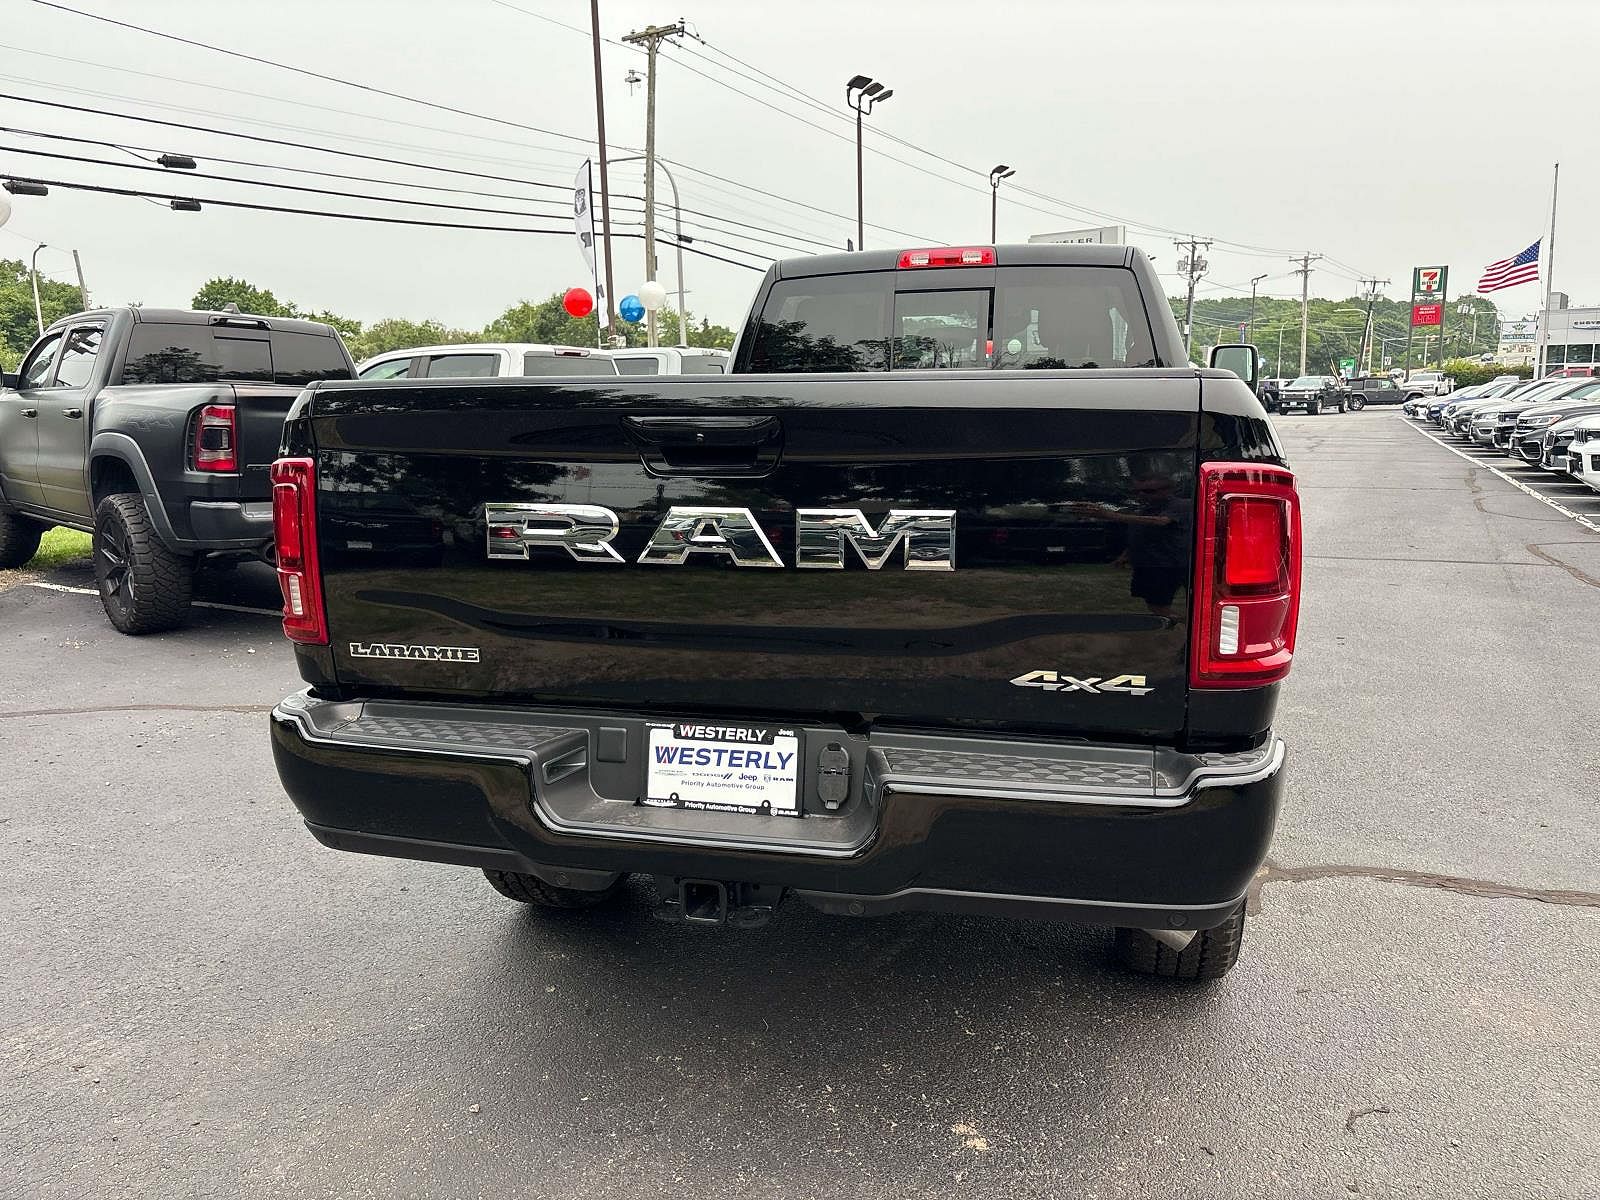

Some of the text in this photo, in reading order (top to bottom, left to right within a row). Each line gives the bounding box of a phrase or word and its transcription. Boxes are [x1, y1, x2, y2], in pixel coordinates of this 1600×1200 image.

[1422, 271, 1438, 293] 7
[485, 502, 957, 572] RAM
[349, 642, 480, 663] LARAMIE
[1009, 669, 1156, 696] 4x4
[679, 724, 767, 742] WESTERLY
[777, 728, 794, 737] Jeep
[655, 745, 795, 770] WESTERLY
[681, 779, 765, 791] Priority Automotive Group
[738, 772, 758, 782] Jeep
[684, 801, 757, 814] Priority Automotive Group
